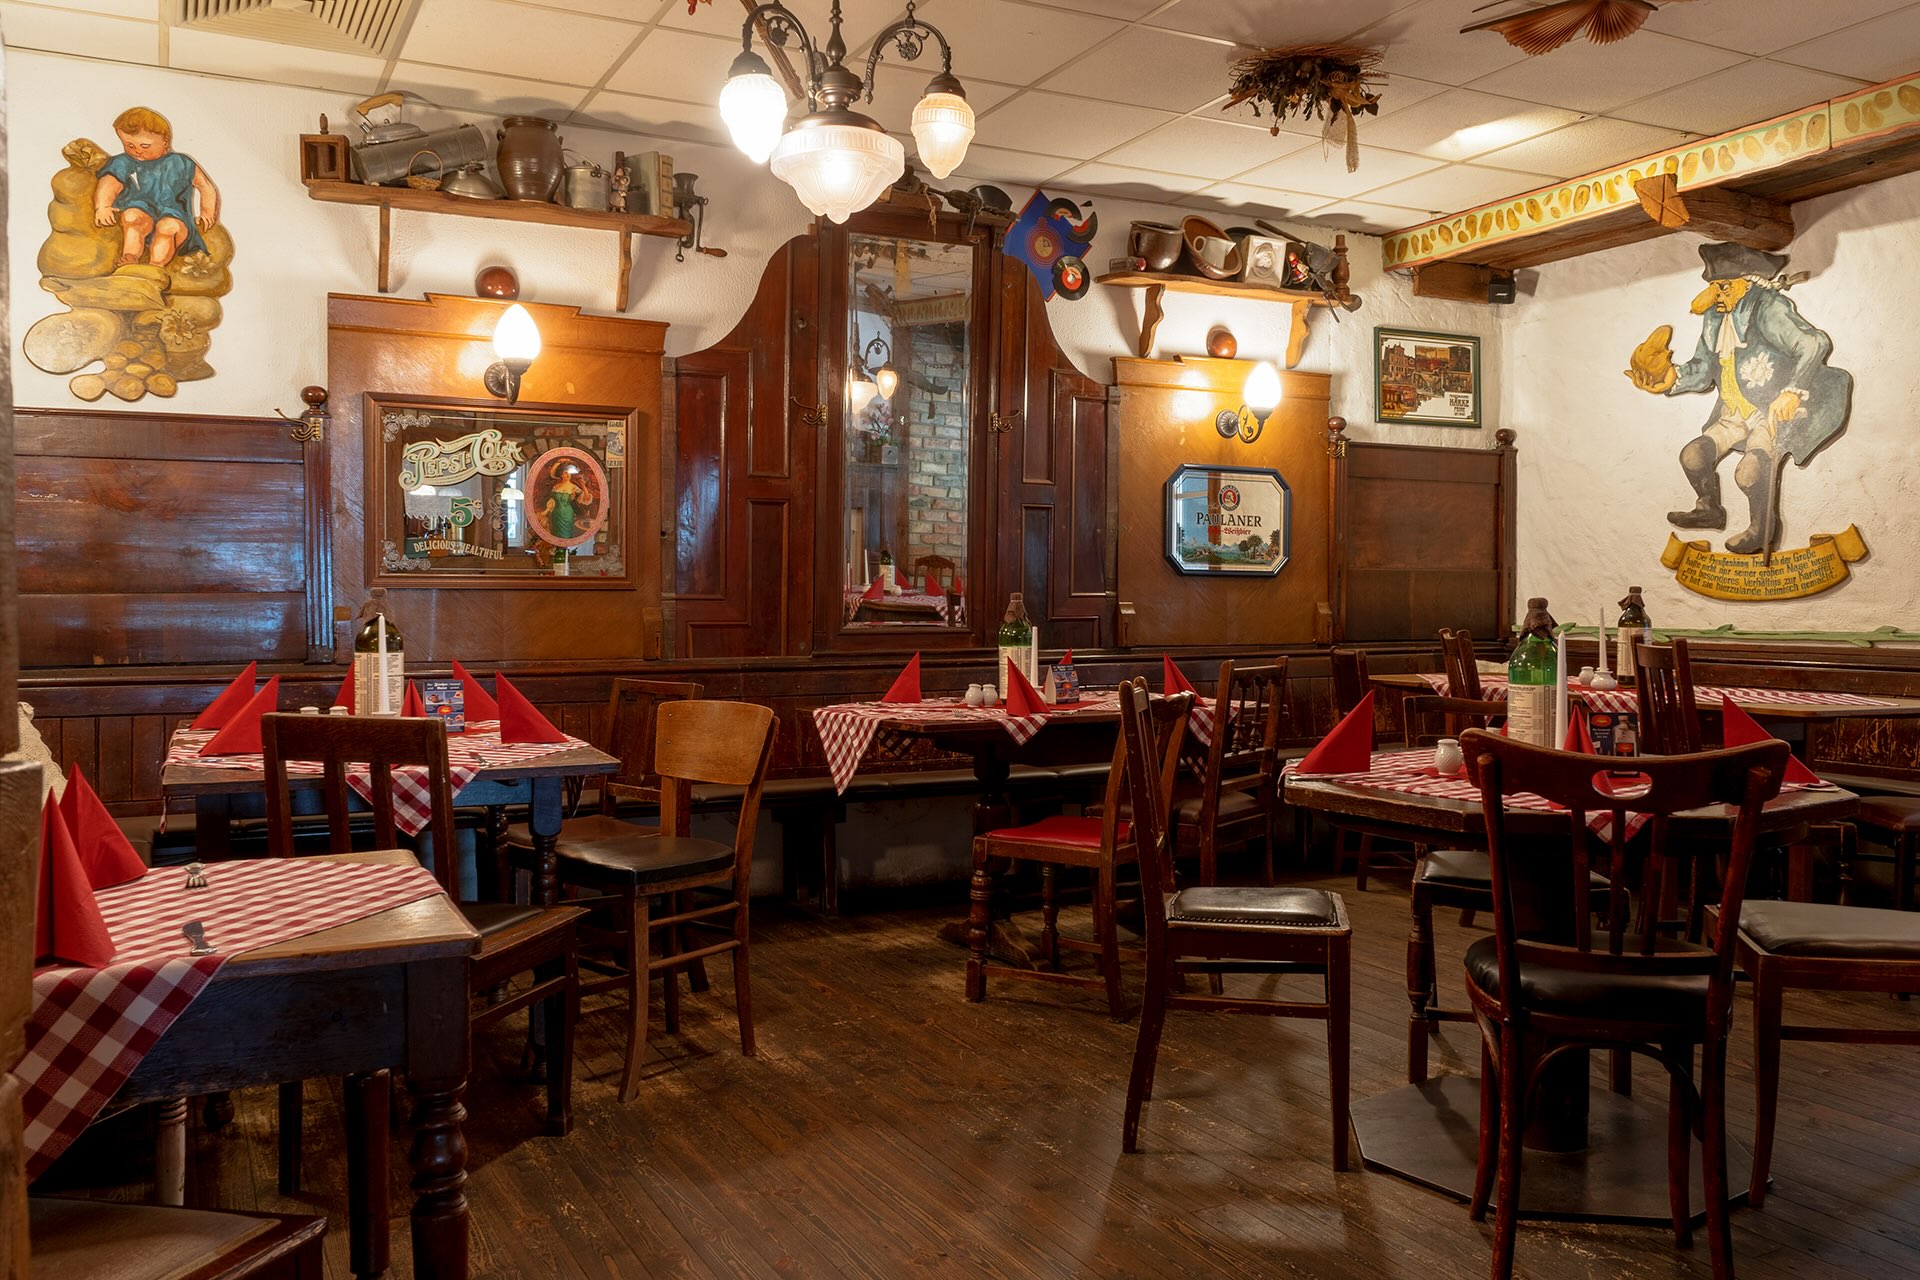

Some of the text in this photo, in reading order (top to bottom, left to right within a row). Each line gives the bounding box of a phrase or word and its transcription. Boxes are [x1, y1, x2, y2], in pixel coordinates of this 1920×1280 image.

[1196, 512, 1262, 527] PAULANER
[413, 540, 504, 560] DELICIOUS HEALTHFUL
[1696, 552, 1707, 562] Der
[1780, 556, 1792, 565] der
[1793, 549, 1817, 562] Große
[1699, 570, 1740, 585] besonderes
[1744, 577, 1781, 587] Verhältnis
[1784, 577, 1796, 585] zur
[1702, 563, 1717, 572] nicht
[1734, 569, 1757, 577] seiner
[1759, 567, 1785, 579] großen
[1787, 561, 1808, 574] Nase
[1690, 575, 1701, 586] hat
[1702, 580, 1714, 589] sie
[1716, 582, 1762, 596] hierzulande
[1765, 583, 1799, 596] heimisch
